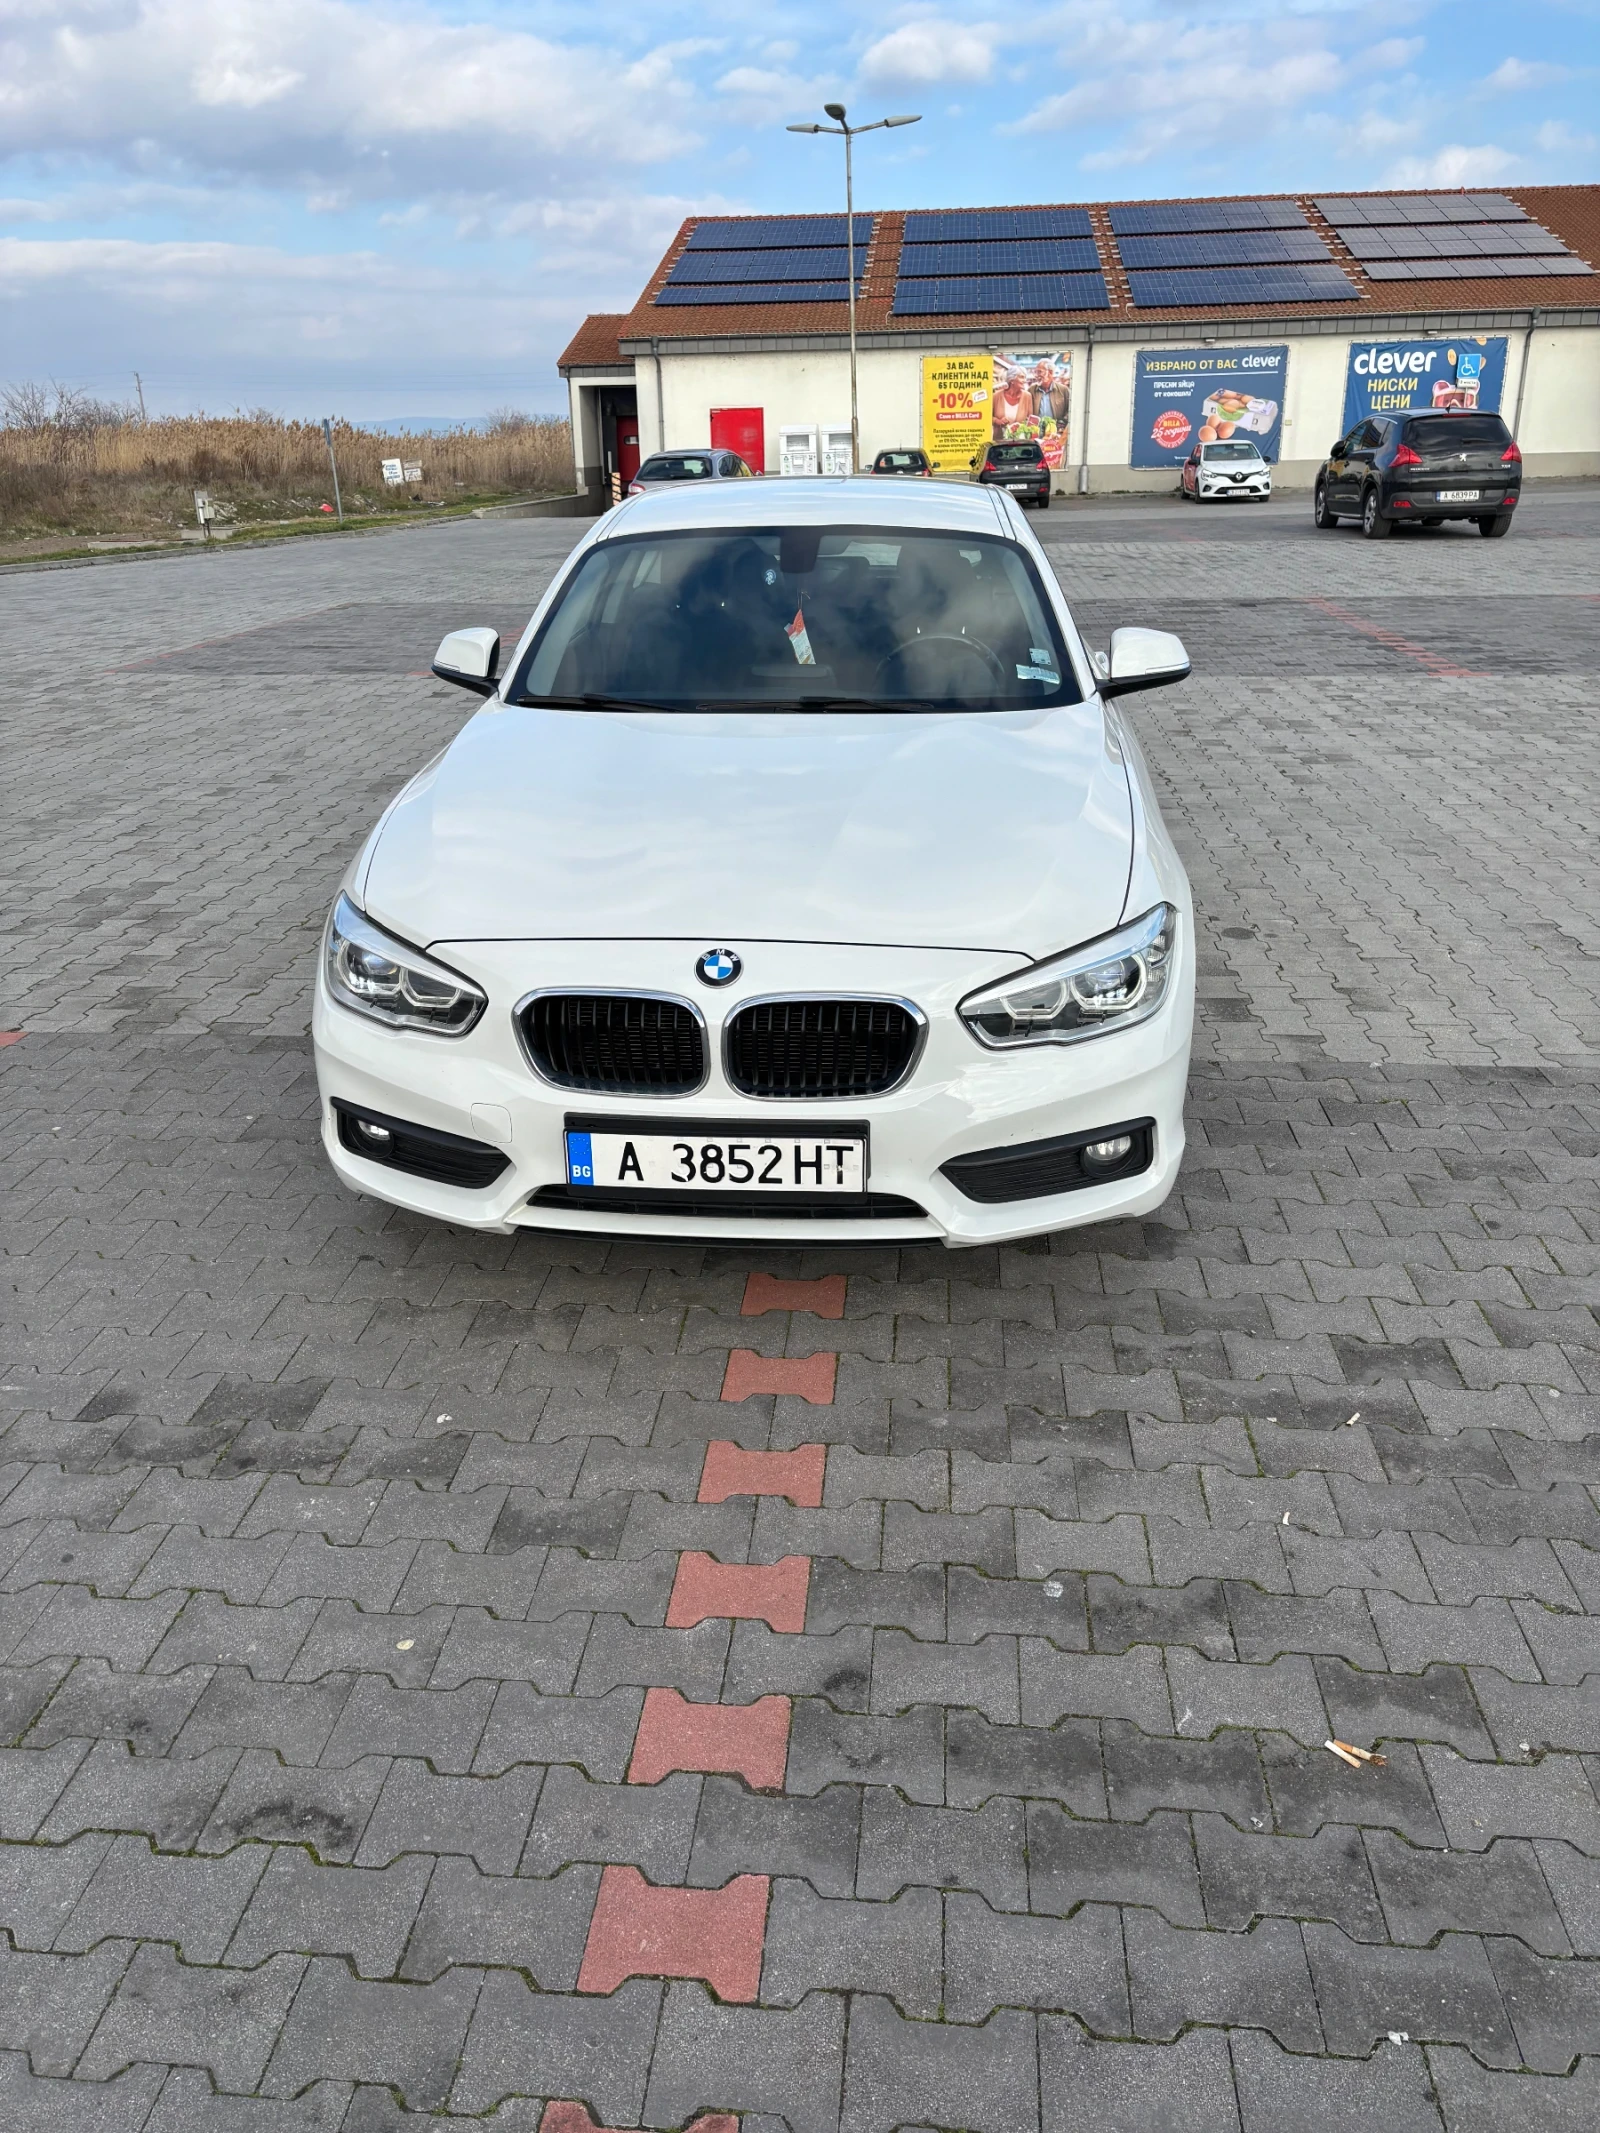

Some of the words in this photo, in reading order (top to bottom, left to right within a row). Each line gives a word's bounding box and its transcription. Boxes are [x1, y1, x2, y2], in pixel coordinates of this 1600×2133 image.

[946, 362, 956, 370] ЗА
[958, 361, 975, 369] ВАС
[1146, 360, 1197, 371] ИЗБРАНО
[1200, 360, 1214, 370] ОТ
[1217, 359, 1238, 369] ВАС
[1241, 354, 1281, 368] clever
[1354, 348, 1437, 375] clever
[932, 371, 969, 381] КЛИЕНТИ
[971, 371, 989, 380] НАД
[949, 381, 982, 390] ГОДИНИ
[1367, 377, 1418, 392] НИСКИ
[932, 392, 974, 409] -10%
[1371, 394, 1411, 412] ЦЕНИ
[701, 949, 740, 961] BMW
[618, 1141, 645, 1182] A
[572, 1165, 591, 1178] BG
